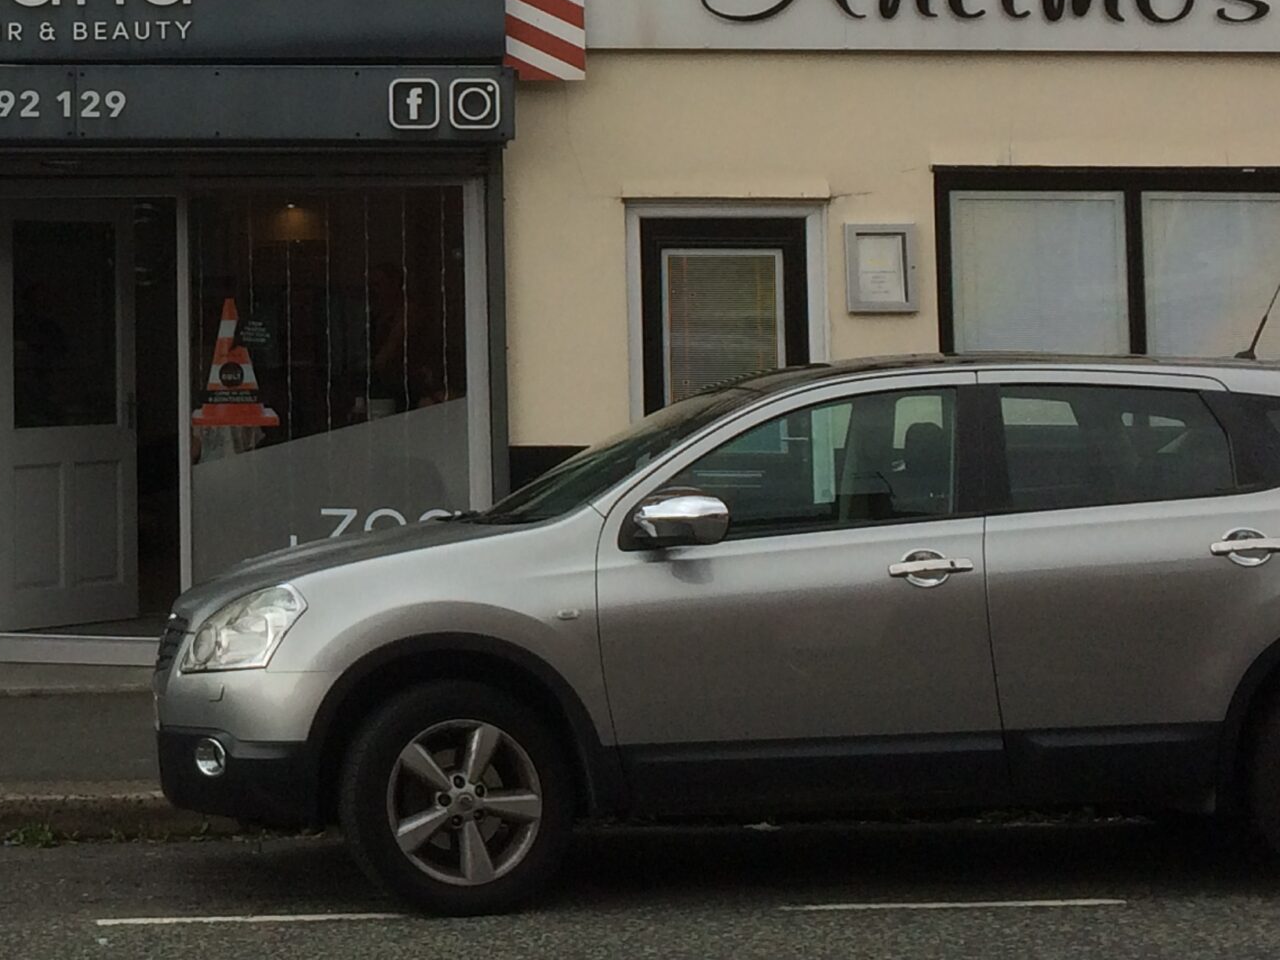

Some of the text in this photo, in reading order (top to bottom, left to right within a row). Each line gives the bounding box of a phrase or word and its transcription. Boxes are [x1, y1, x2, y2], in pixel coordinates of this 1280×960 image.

[38, 22, 56, 41] &
[72, 20, 193, 41] BEAUTY
[55, 89, 127, 118] 129
